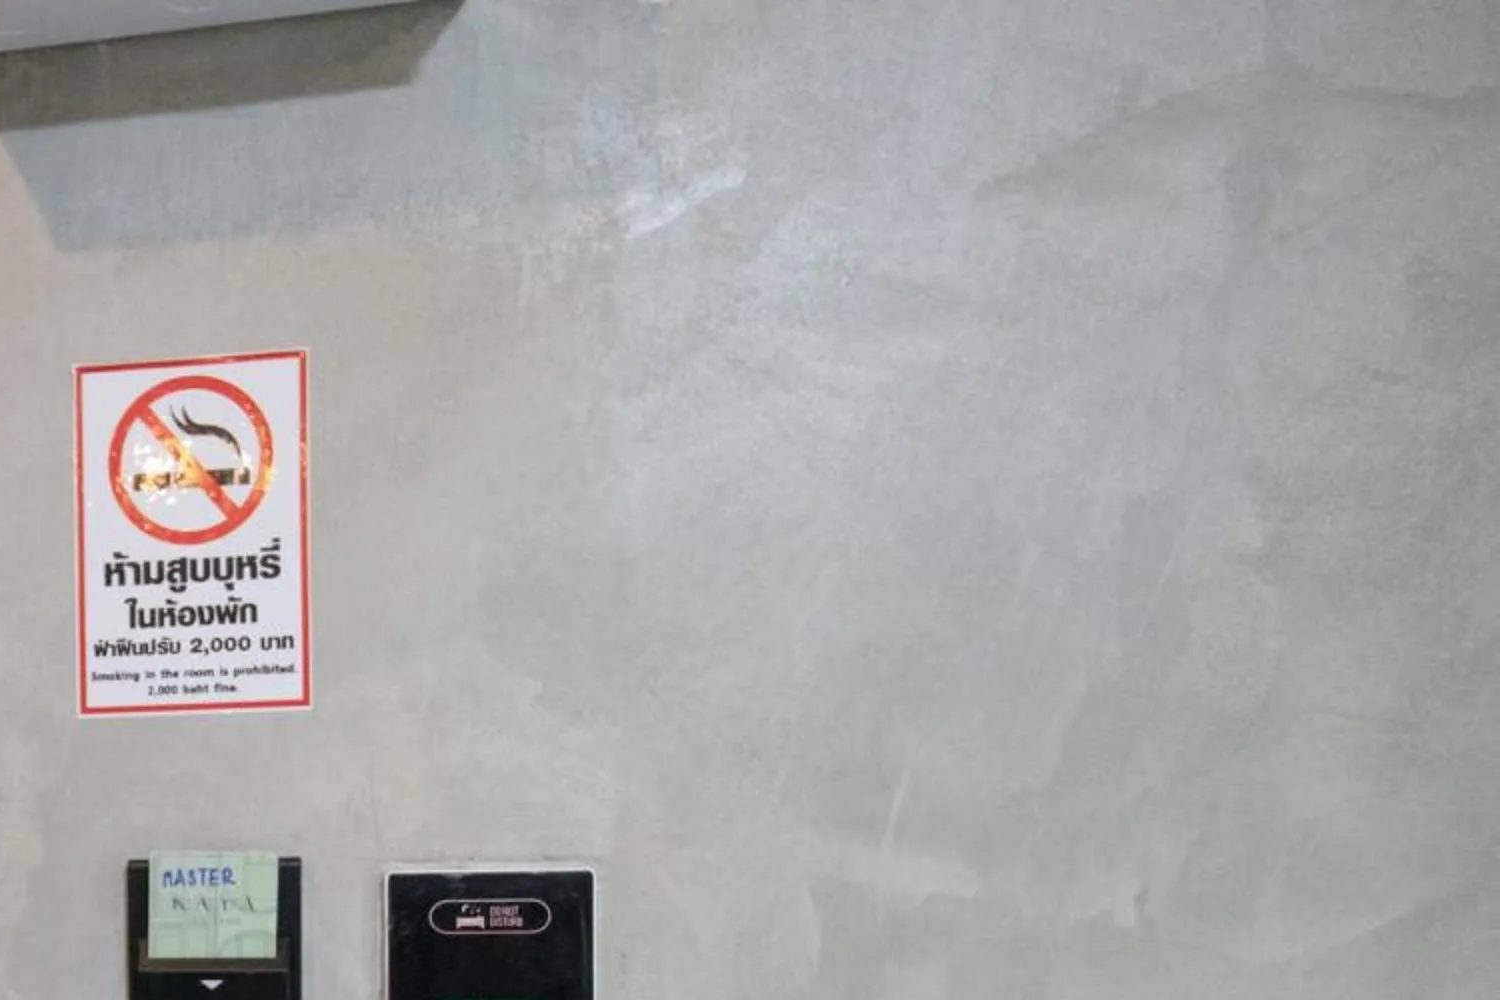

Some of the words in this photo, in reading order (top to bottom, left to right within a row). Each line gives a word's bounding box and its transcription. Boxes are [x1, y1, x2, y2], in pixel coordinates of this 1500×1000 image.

[104, 538, 281, 593] ห้ามสูบบุหรี่
[124, 597, 258, 629] ในห้องพัก
[190, 636, 251, 655] 2,000
[261, 635, 295, 650] บาท
[92, 671, 140, 682] Smoking
[145, 669, 156, 679] in
[161, 668, 179, 679] the
[184, 668, 214, 678] room
[219, 665, 229, 676] is
[148, 685, 178, 696] 2,000
[183, 683, 209, 694] baht
[162, 867, 236, 888] MASTER
